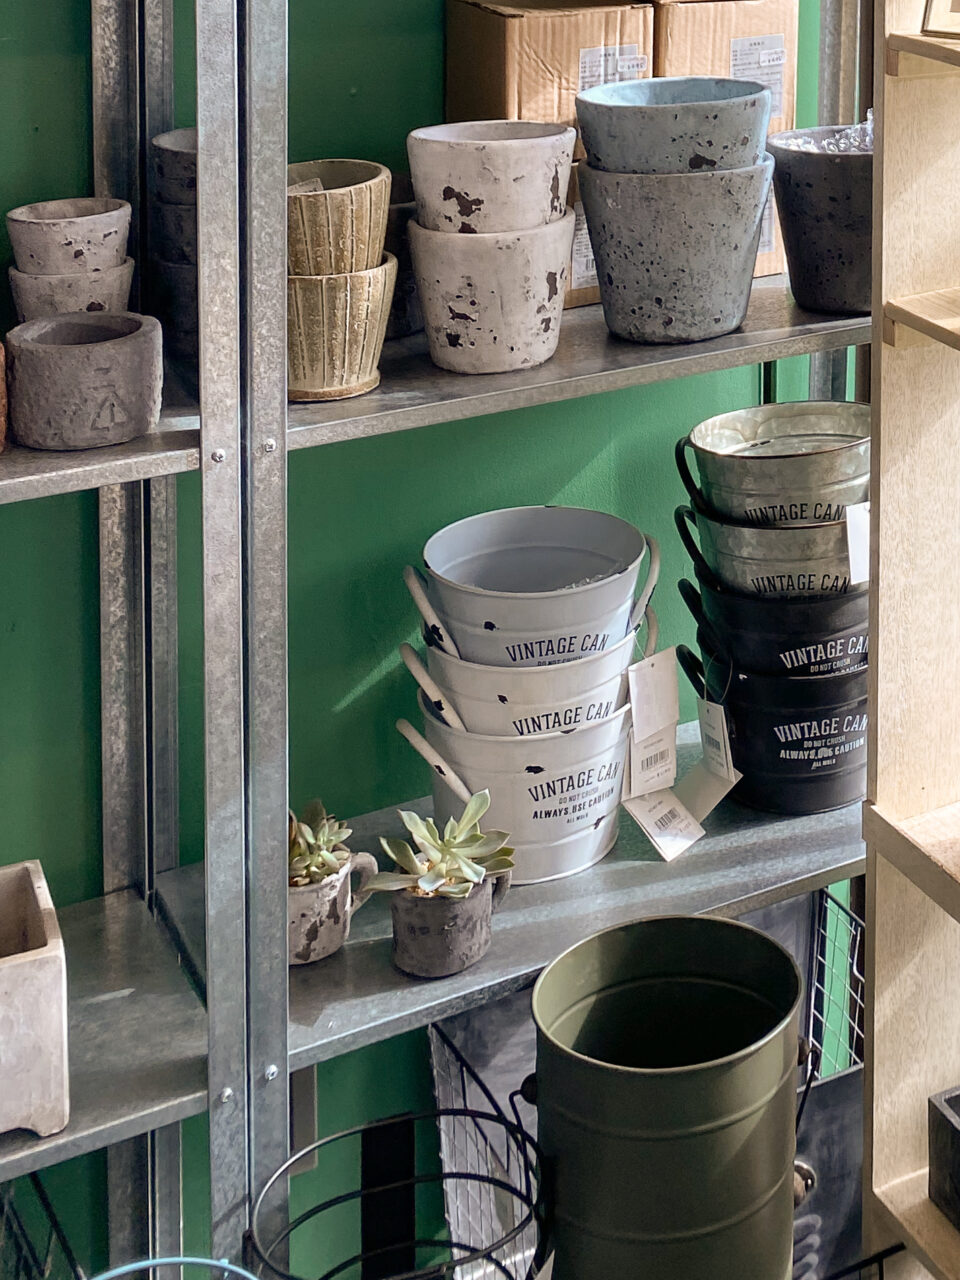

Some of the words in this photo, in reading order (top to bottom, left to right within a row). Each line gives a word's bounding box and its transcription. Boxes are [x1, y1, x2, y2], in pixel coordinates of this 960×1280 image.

[744, 502, 808, 521] VINTAGE
[813, 502, 845, 521] CAN
[751, 574, 816, 594] VINTAGE
[821, 574, 851, 594] CAN
[505, 636, 577, 662] VINTAGE
[581, 634, 609, 652] CAN
[780, 639, 845, 669] VINTAGE
[810, 665, 819, 673] DO
[820, 662, 832, 672] NOT
[512, 707, 583, 736] VINTAGE
[586, 701, 613, 721] CAN
[774, 718, 840, 743] VINTAGE
[843, 714, 869, 732] CAN
[803, 740, 812, 748] DO
[813, 738, 826, 748] NOT
[835, 737, 865, 755] CAUTION
[528, 769, 595, 802] VINTAGE
[597, 761, 621, 782] CAN
[568, 793, 581, 803] NOT
[588, 787, 615, 808] CAUTION
